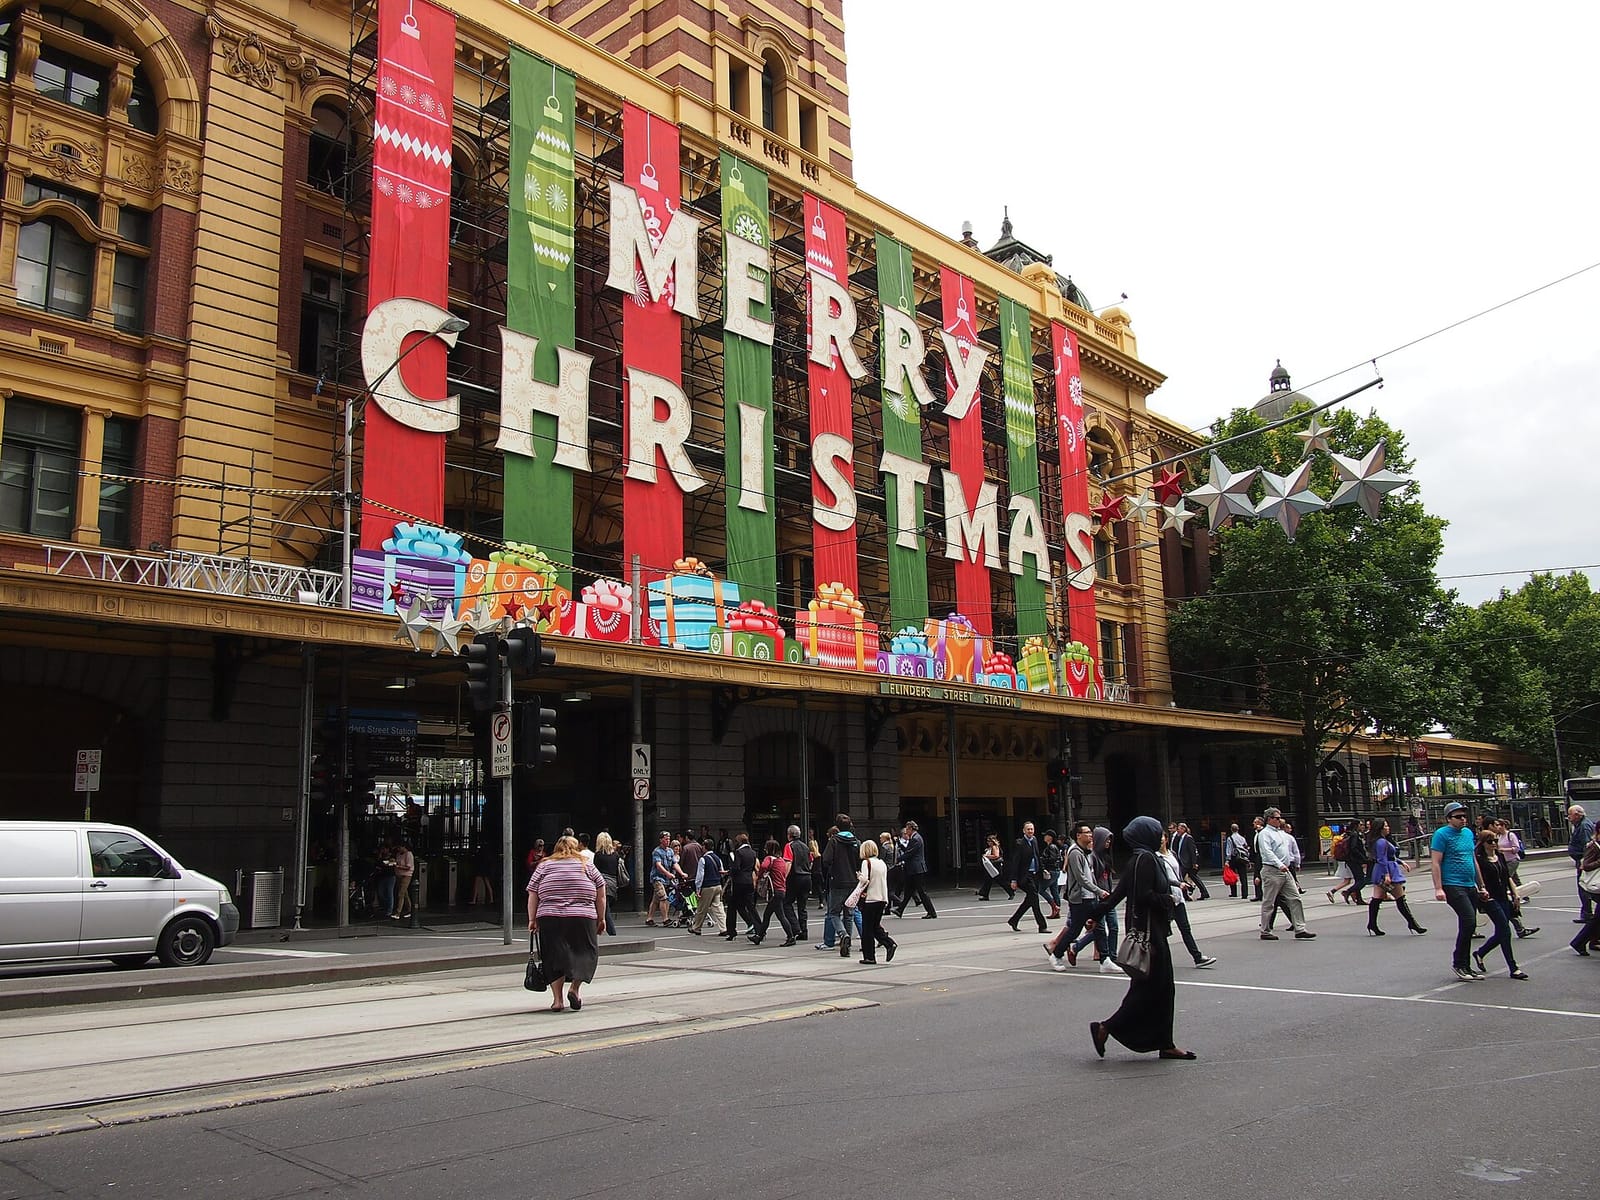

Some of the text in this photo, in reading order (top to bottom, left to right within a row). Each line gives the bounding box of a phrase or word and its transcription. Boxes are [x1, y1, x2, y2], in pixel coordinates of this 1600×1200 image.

[605, 178, 990, 420] MERRY
[361, 296, 1096, 591] CHRISTMAS
[889, 684, 1016, 707] FLINDERS STREET STATION
[367, 725, 389, 735] Street
[391, 726, 416, 736] Station
[496, 743, 508, 755] NO
[494, 755, 510, 764] RIGHT
[494, 765, 510, 773] TURN
